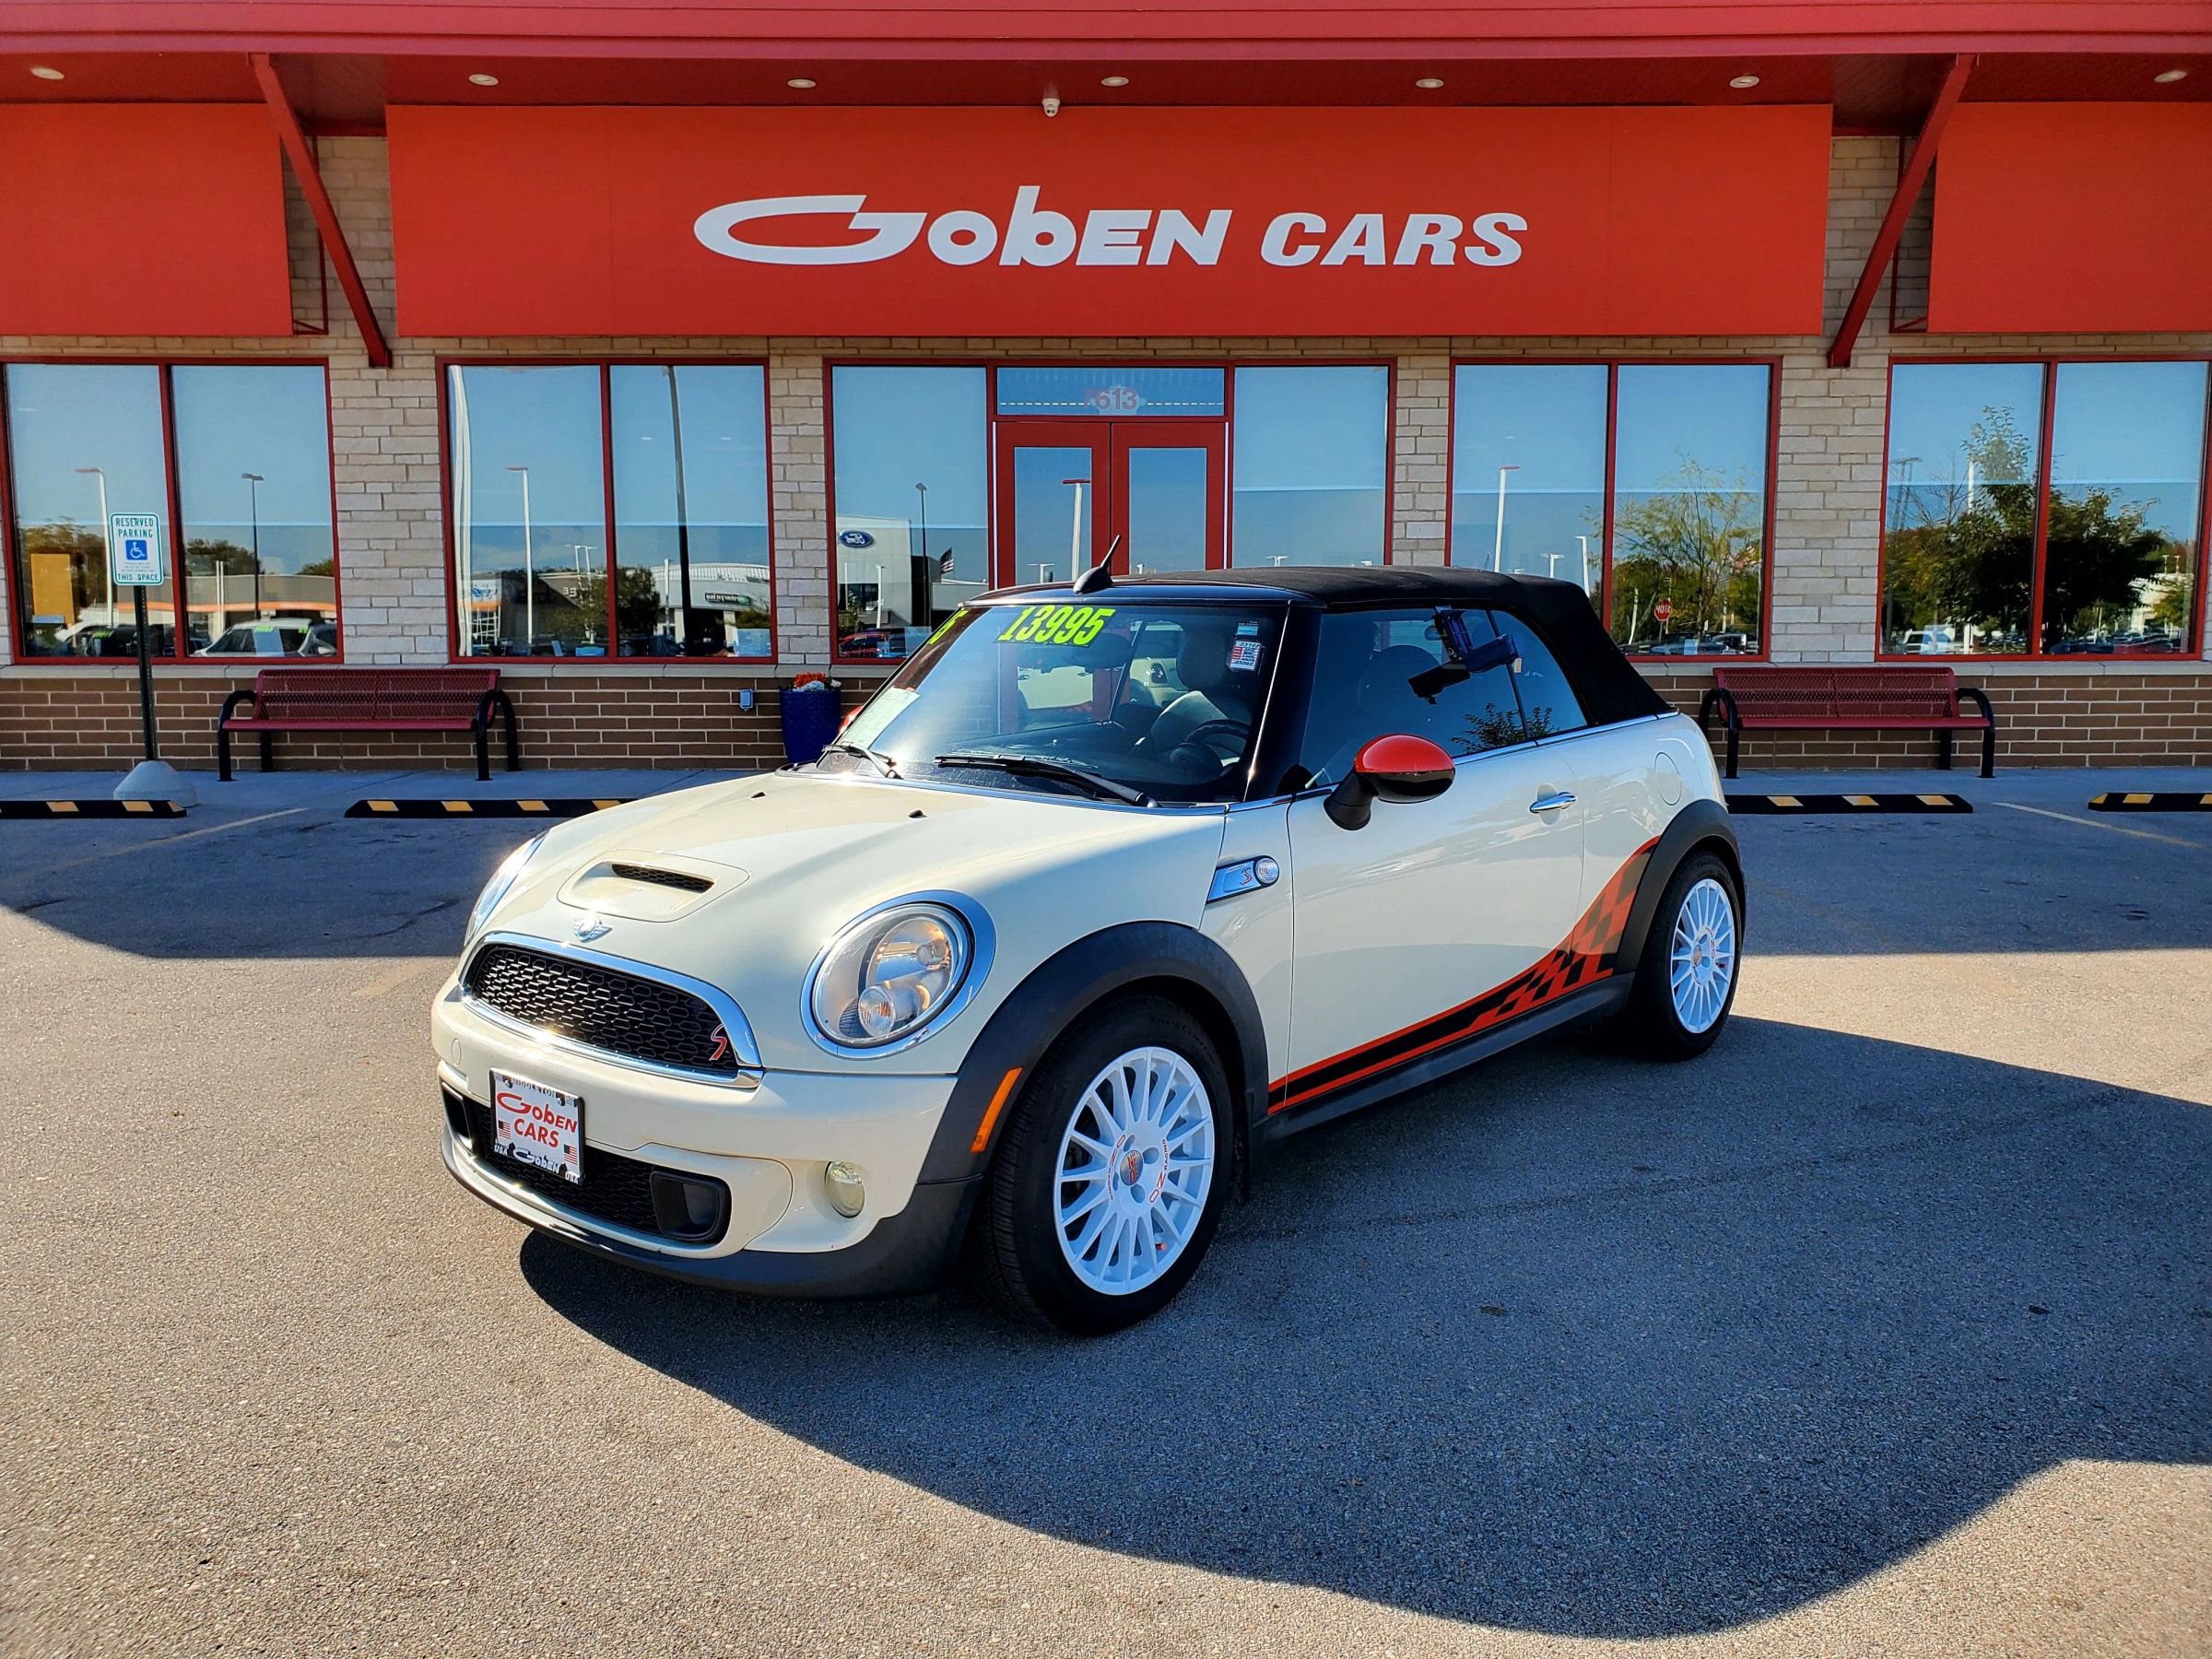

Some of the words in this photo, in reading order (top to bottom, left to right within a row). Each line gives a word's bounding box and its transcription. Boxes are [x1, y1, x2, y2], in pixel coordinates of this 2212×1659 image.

[1260, 211, 1528, 267] CARS
[115, 517, 154, 527] RESERVED
[118, 528, 153, 538] PARKING
[997, 605, 1116, 645] 13995
[513, 1118, 559, 1148] CARS
[494, 1144, 508, 1156] USA
